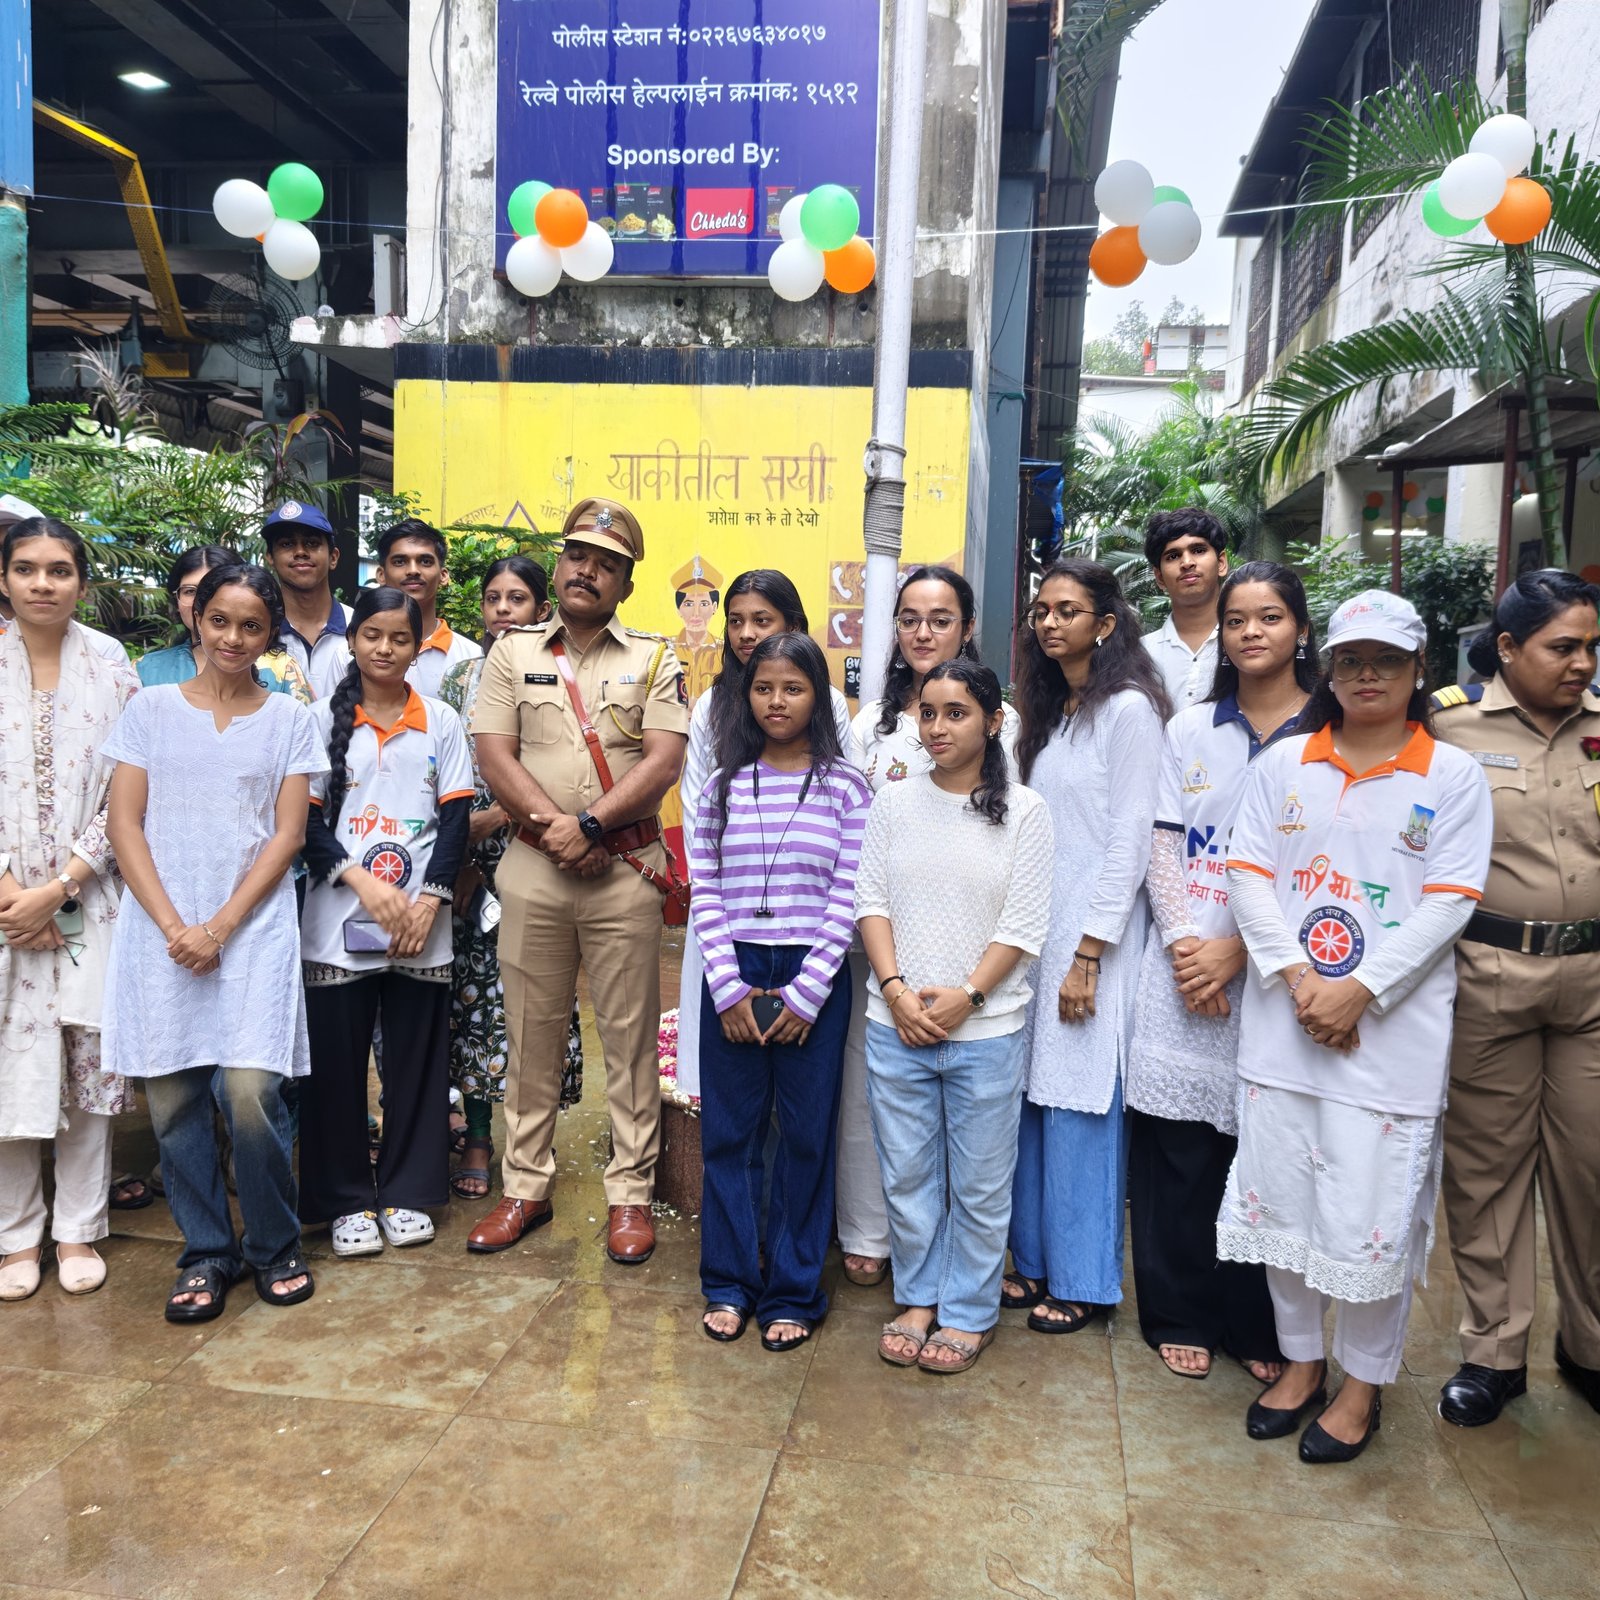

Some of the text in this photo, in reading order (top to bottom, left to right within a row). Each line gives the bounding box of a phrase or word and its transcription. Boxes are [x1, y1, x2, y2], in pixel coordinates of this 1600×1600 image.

[552, 24, 607, 47] पोलीस
[612, 23, 662, 46] स्टेशन
[519, 77, 859, 107] रेल्वे पोलीस हेल्पलाईन क्रमांक: १५१२
[607, 142, 779, 169] Sponsored By:
[691, 209, 747, 231] Chheda's
[606, 438, 837, 503] खाकीतील सखी
[707, 507, 820, 527] भरोसा कर के तो देखो
[846, 657, 860, 669] BV
[1206, 860, 1225, 875] ME
[1213, 889, 1229, 907] पर
